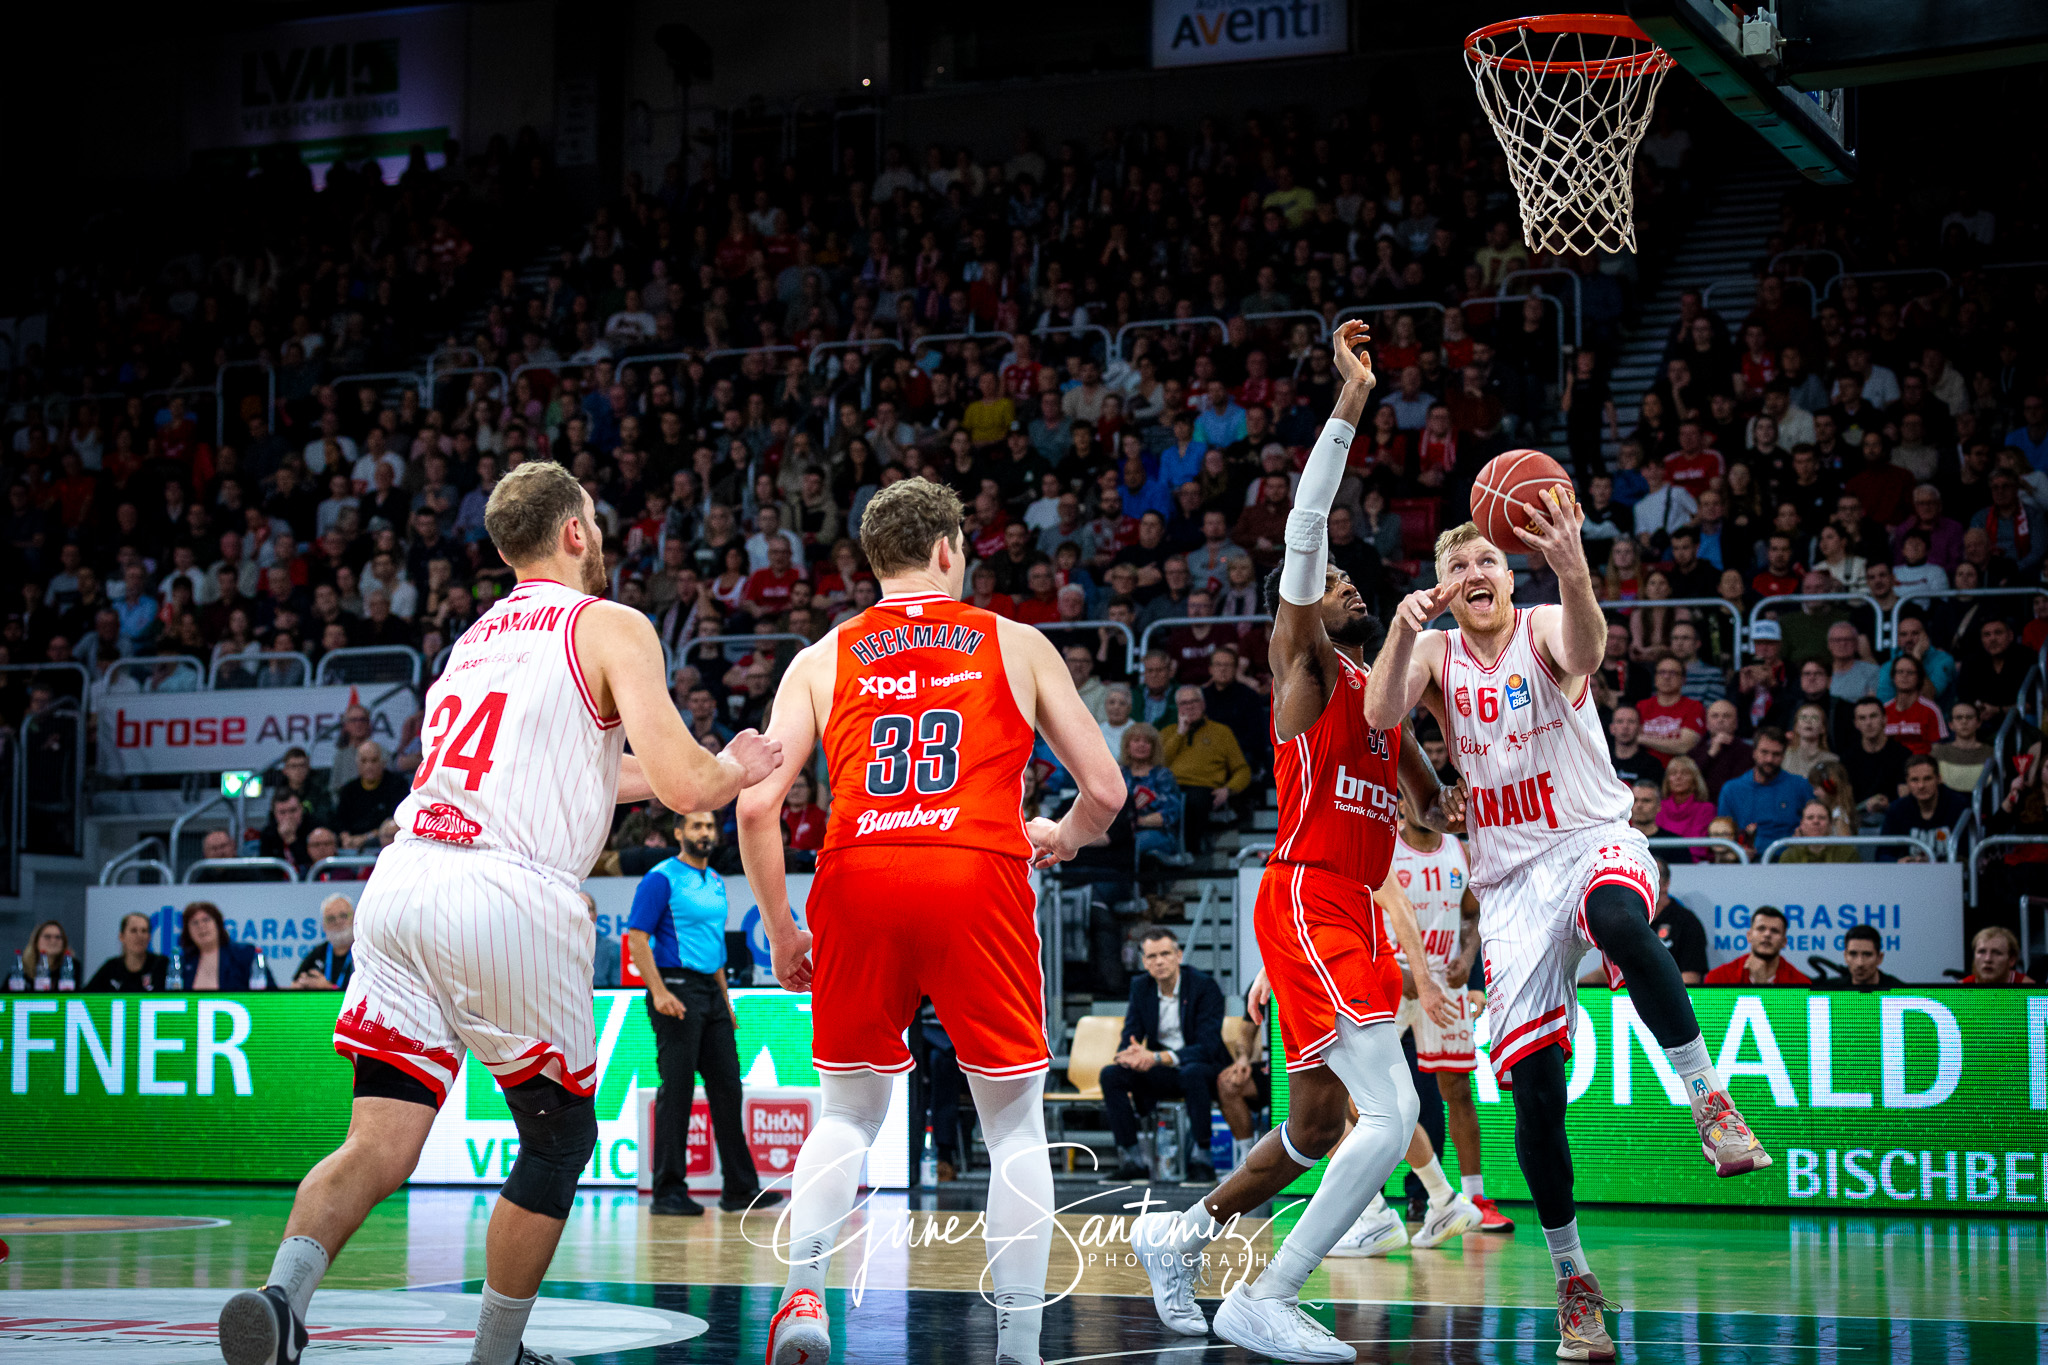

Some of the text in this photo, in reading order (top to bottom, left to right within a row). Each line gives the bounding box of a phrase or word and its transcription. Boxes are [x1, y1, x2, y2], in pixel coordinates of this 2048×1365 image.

[241, 43, 347, 106] LVM
[850, 624, 985, 666] HECKMANN
[857, 670, 983, 700] xpd logistics
[1512, 695, 1530, 708] BBL
[1478, 687, 1499, 723] 6
[116, 709, 395, 749] brose AREA
[411, 691, 508, 792] 34
[865, 709, 963, 797] 33
[855, 803, 960, 838] Bamberg
[1334, 801, 1366, 816] Technik
[1366, 809, 1378, 819] für
[1421, 866, 1441, 892] 11
[223, 917, 326, 941] GARAS
[1714, 904, 1900, 930] IGRASHI
[1714, 935, 1900, 951] MOREN GH
[0, 999, 254, 1097] FNER
[753, 1131, 804, 1146] SPRUDEL
[1787, 1149, 2048, 1204] BISCHBE
